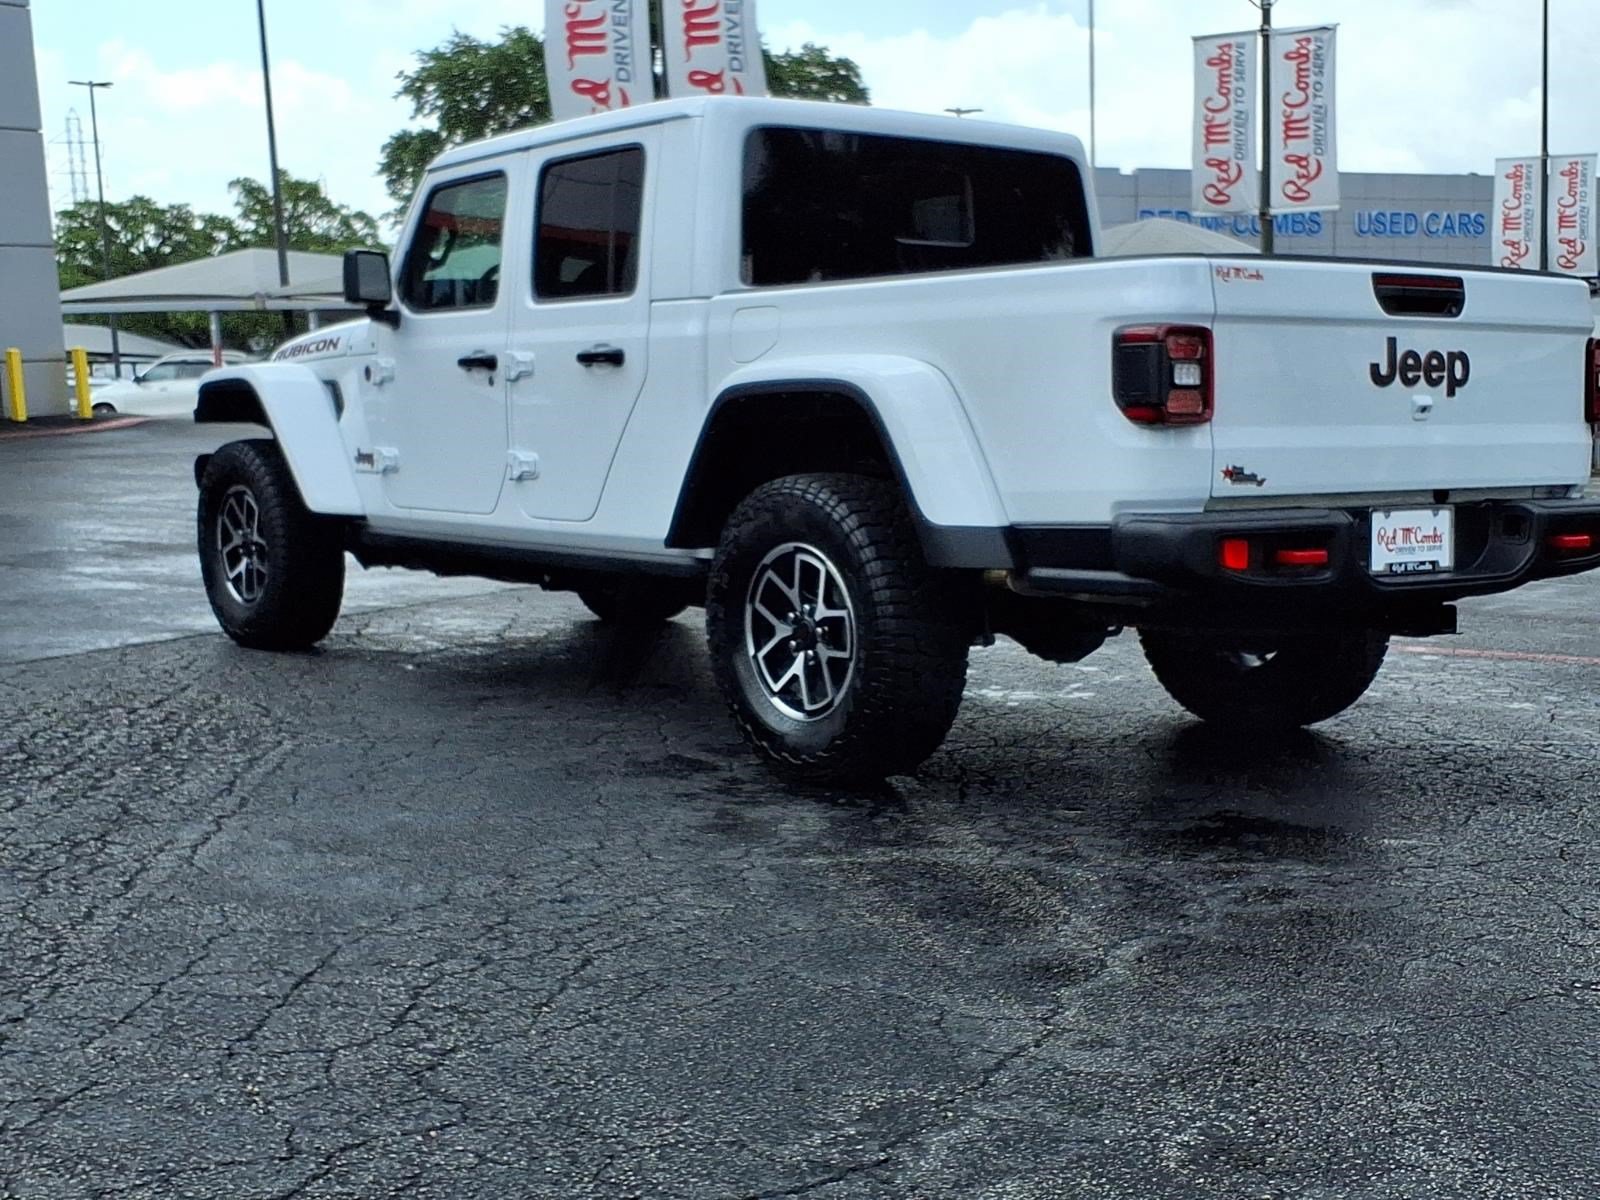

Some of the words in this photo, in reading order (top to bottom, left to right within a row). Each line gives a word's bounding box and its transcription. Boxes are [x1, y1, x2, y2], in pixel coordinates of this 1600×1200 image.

[724, 0, 743, 72] DRIVE
[1234, 42, 1246, 83] SERVE
[1203, 43, 1233, 152] McCombs
[1234, 86, 1244, 105] TO
[1282, 37, 1312, 150] McCombs
[1312, 80, 1323, 100] TO
[1234, 109, 1246, 161] DRIVEN
[1313, 104, 1325, 156] DRIVEN
[1203, 157, 1242, 205] Red
[1282, 154, 1322, 202] Red
[1355, 211, 1418, 236] USED
[1423, 212, 1486, 237] CARS
[1501, 239, 1528, 268] Red
[1556, 238, 1585, 269] Red
[273, 337, 340, 362] RUBICON
[1369, 336, 1470, 398] Jeep
[1377, 527, 1397, 552] Red
